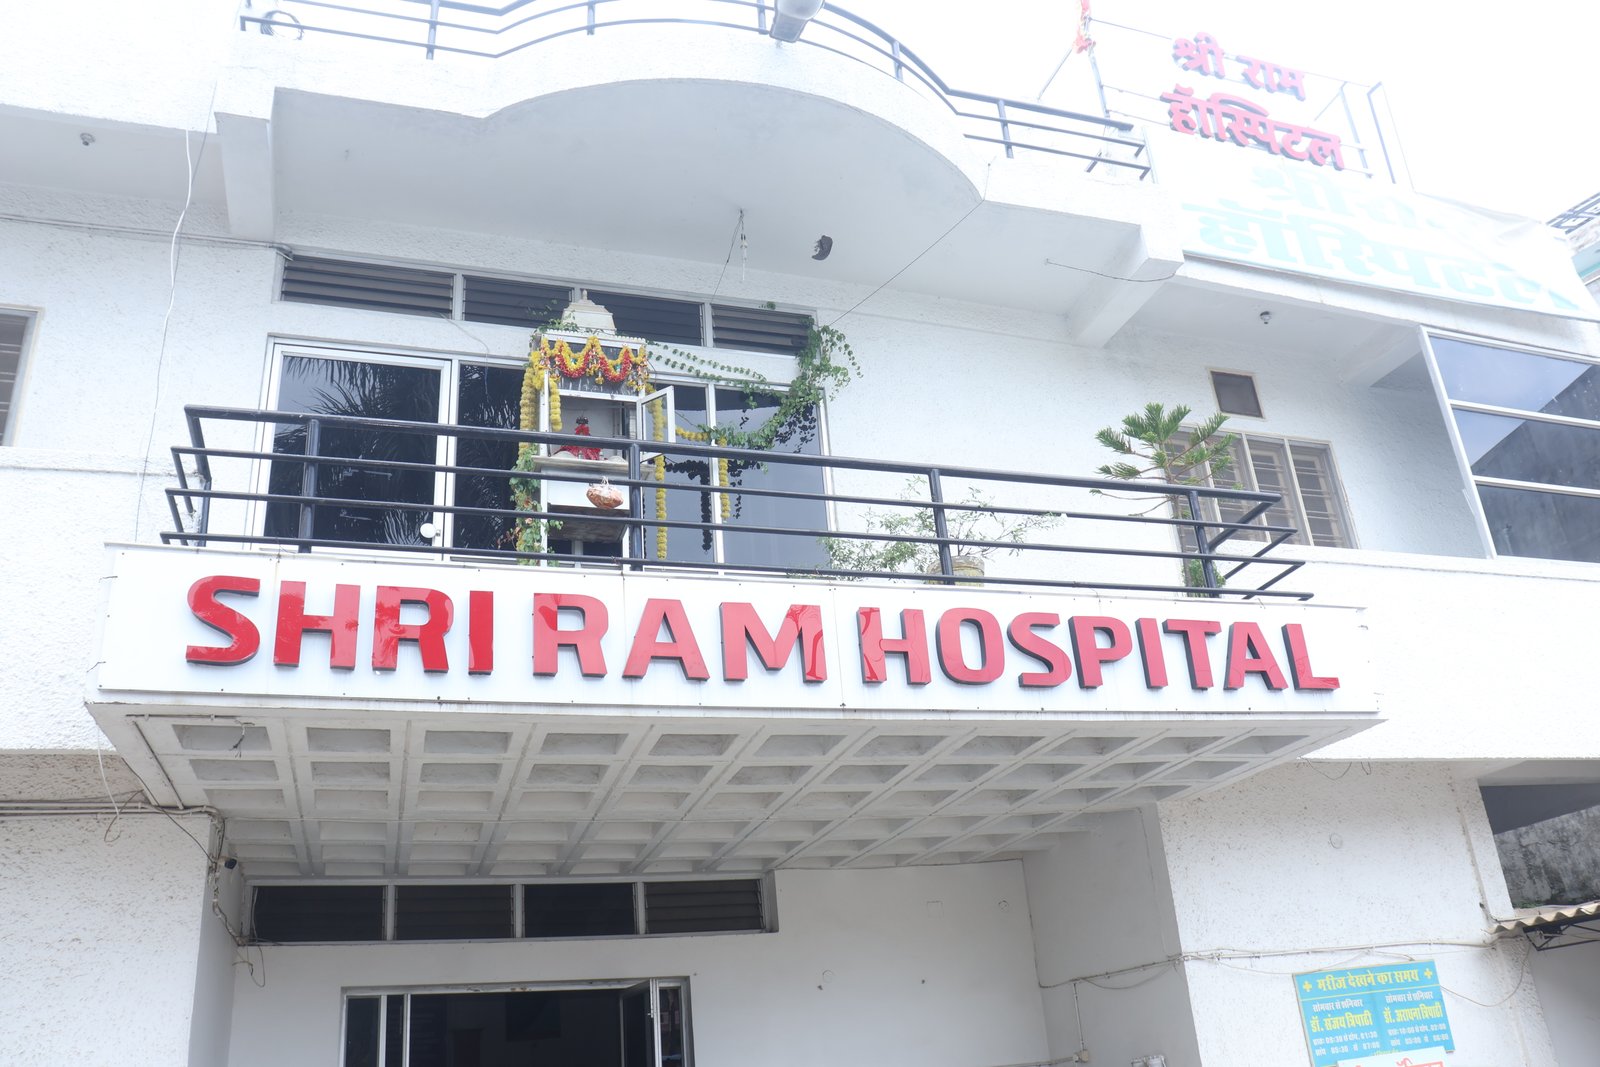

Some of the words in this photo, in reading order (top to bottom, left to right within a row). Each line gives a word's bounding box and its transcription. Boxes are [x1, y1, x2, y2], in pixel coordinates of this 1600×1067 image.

[1172, 32, 1225, 79] श्री
[1235, 55, 1306, 101] राम
[1160, 84, 1344, 171] हॉस्पिटल
[186, 575, 494, 675] SHRI
[533, 593, 826, 683] RAM
[857, 605, 1340, 691] HOSPITAL
[1317, 975, 1346, 991] मरीज
[1348, 970, 1375, 987] देखने
[1377, 971, 1392, 984] का
[1394, 969, 1419, 982] समय
[1325, 1014, 1346, 1030] संजय
